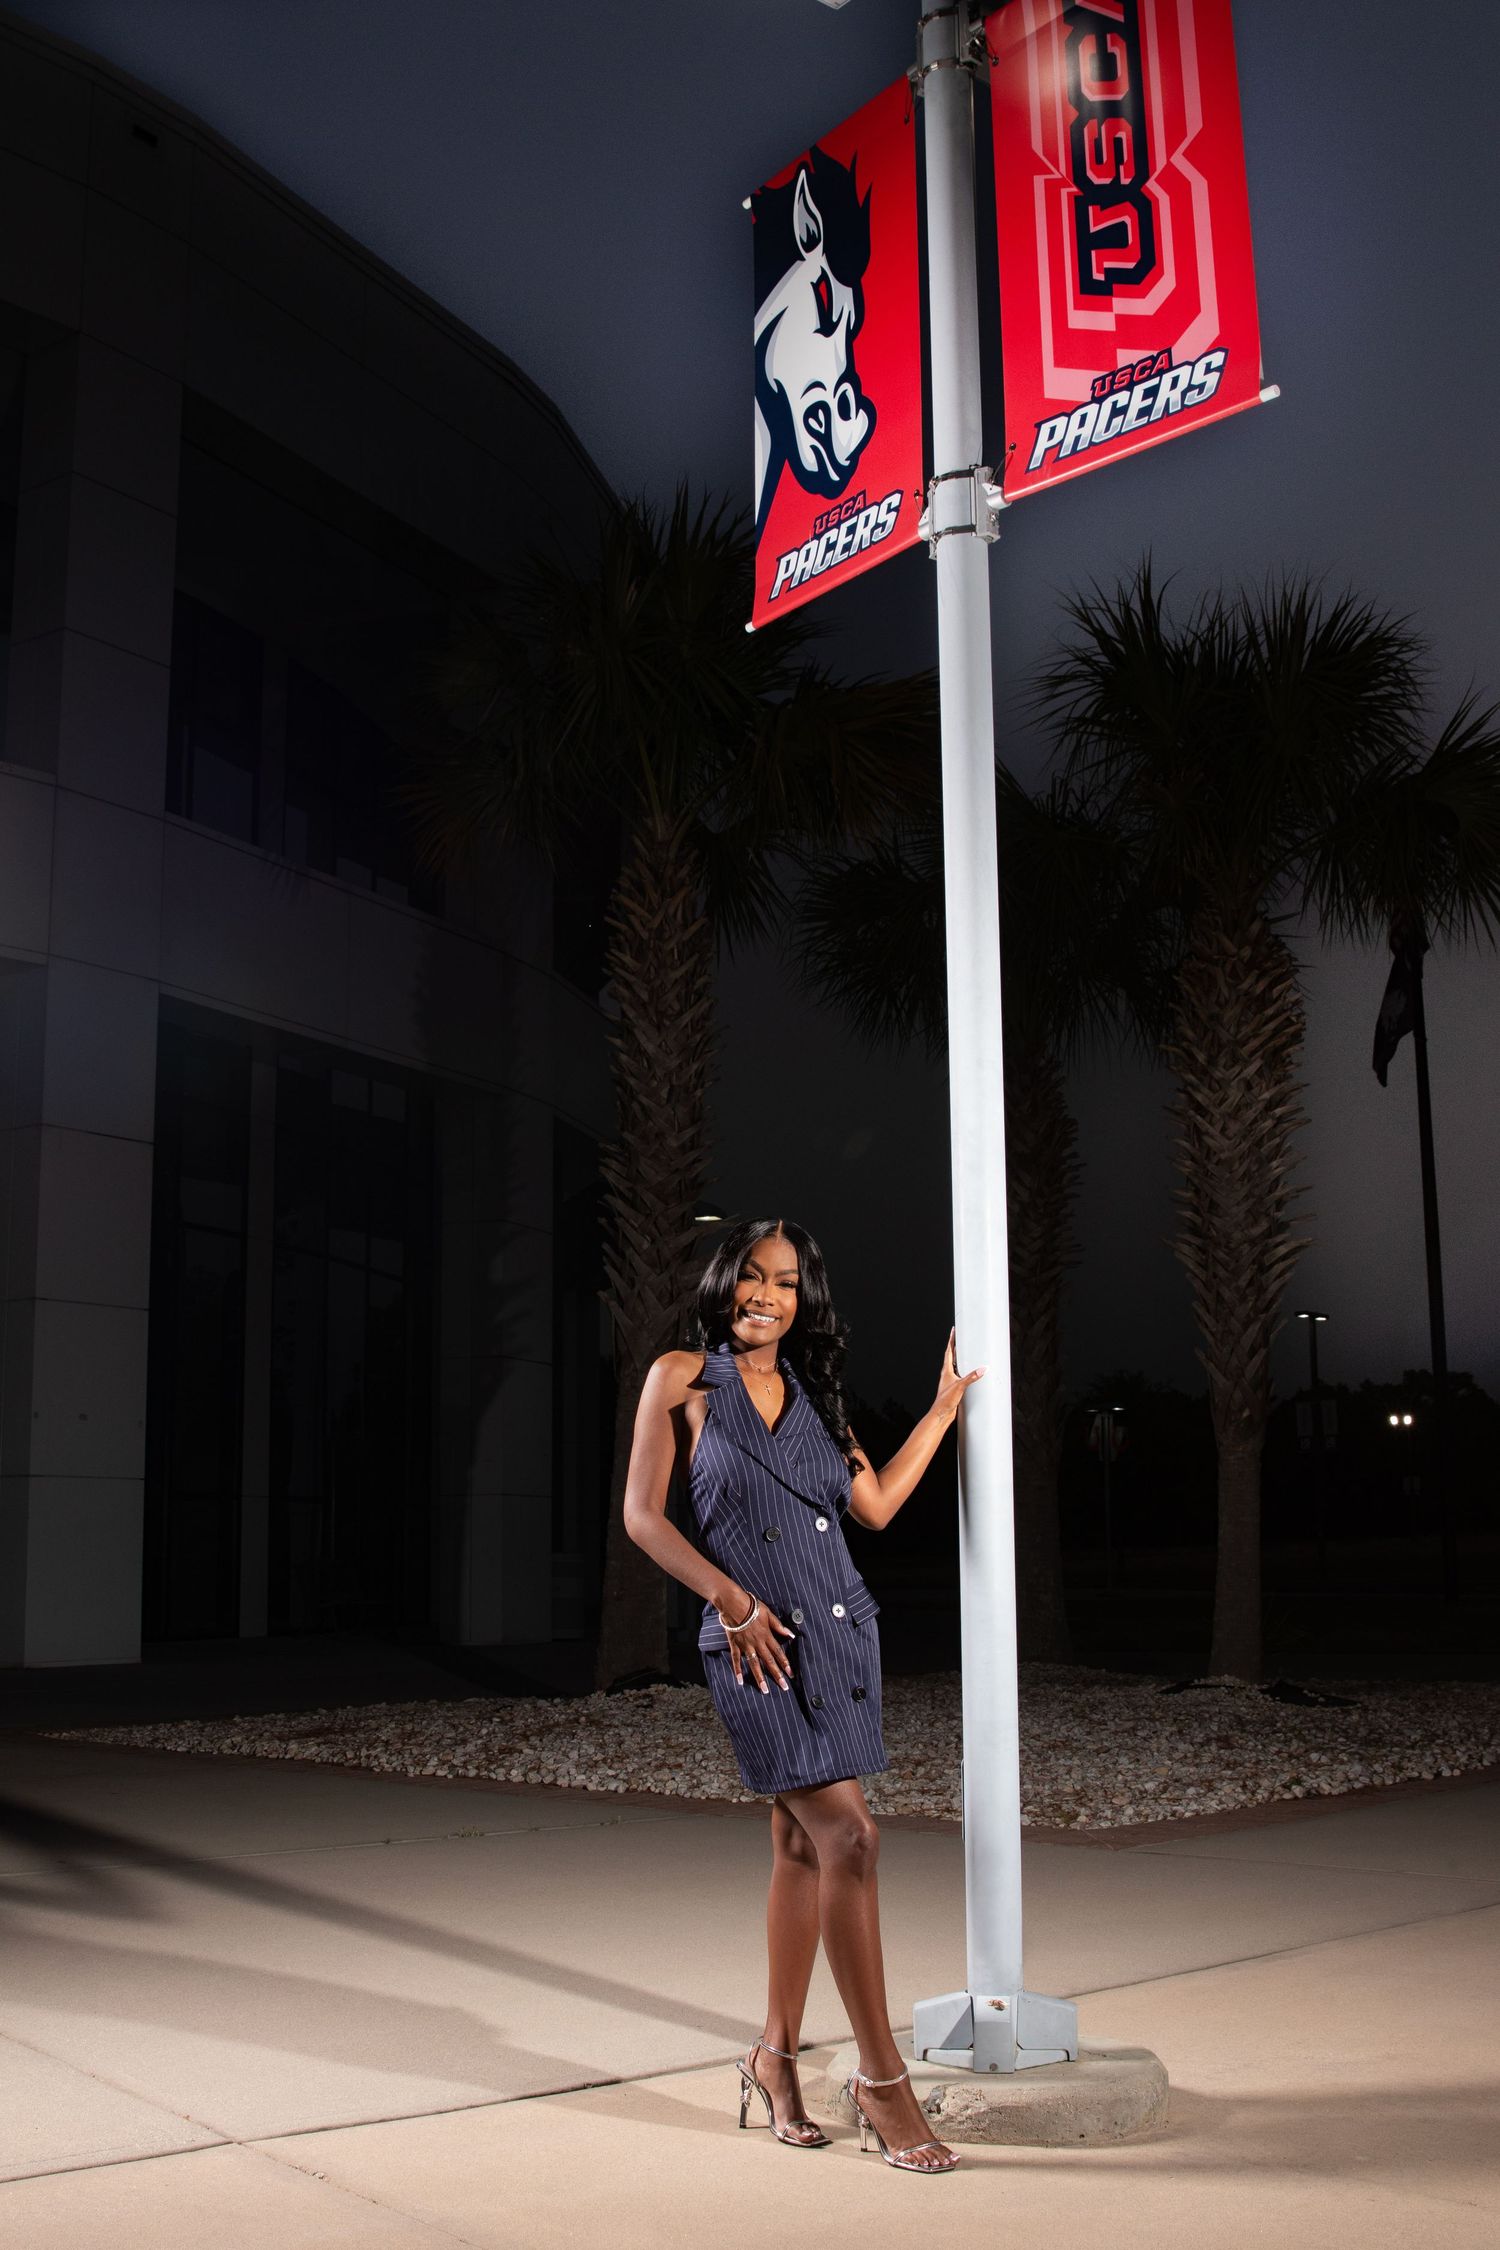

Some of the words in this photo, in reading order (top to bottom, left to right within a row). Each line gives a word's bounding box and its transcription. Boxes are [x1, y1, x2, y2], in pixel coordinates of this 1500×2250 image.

[1028, 349, 1226, 470] PACERS
[1093, 352, 1170, 398] USCA
[770, 492, 902, 600] PACERS
[814, 493, 865, 534] USCA
